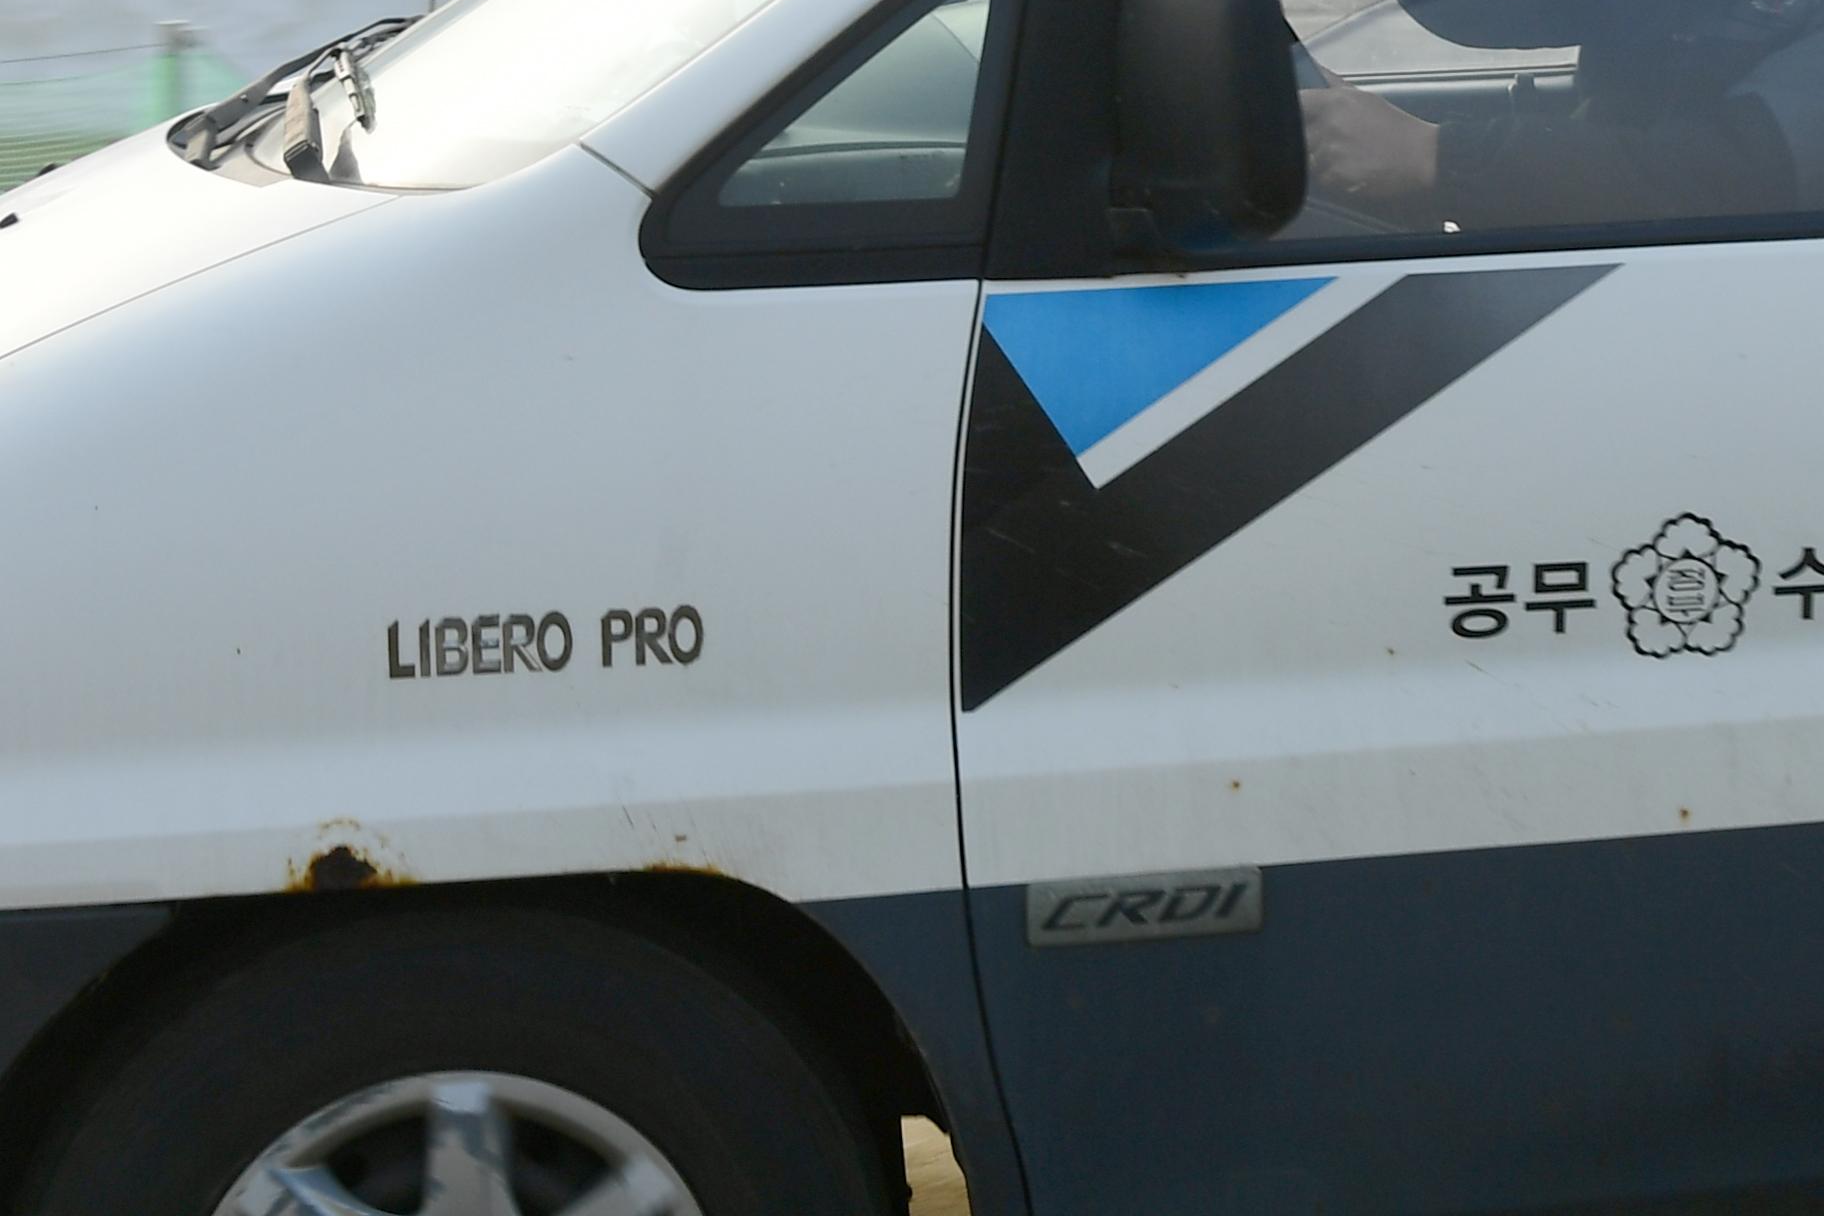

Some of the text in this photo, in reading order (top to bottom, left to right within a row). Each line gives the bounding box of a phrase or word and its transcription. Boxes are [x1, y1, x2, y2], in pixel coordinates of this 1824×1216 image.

[1443, 562, 1596, 639] 공무
[387, 604, 704, 679] LIBERO PRO
[1042, 884, 1248, 931] CRDI
